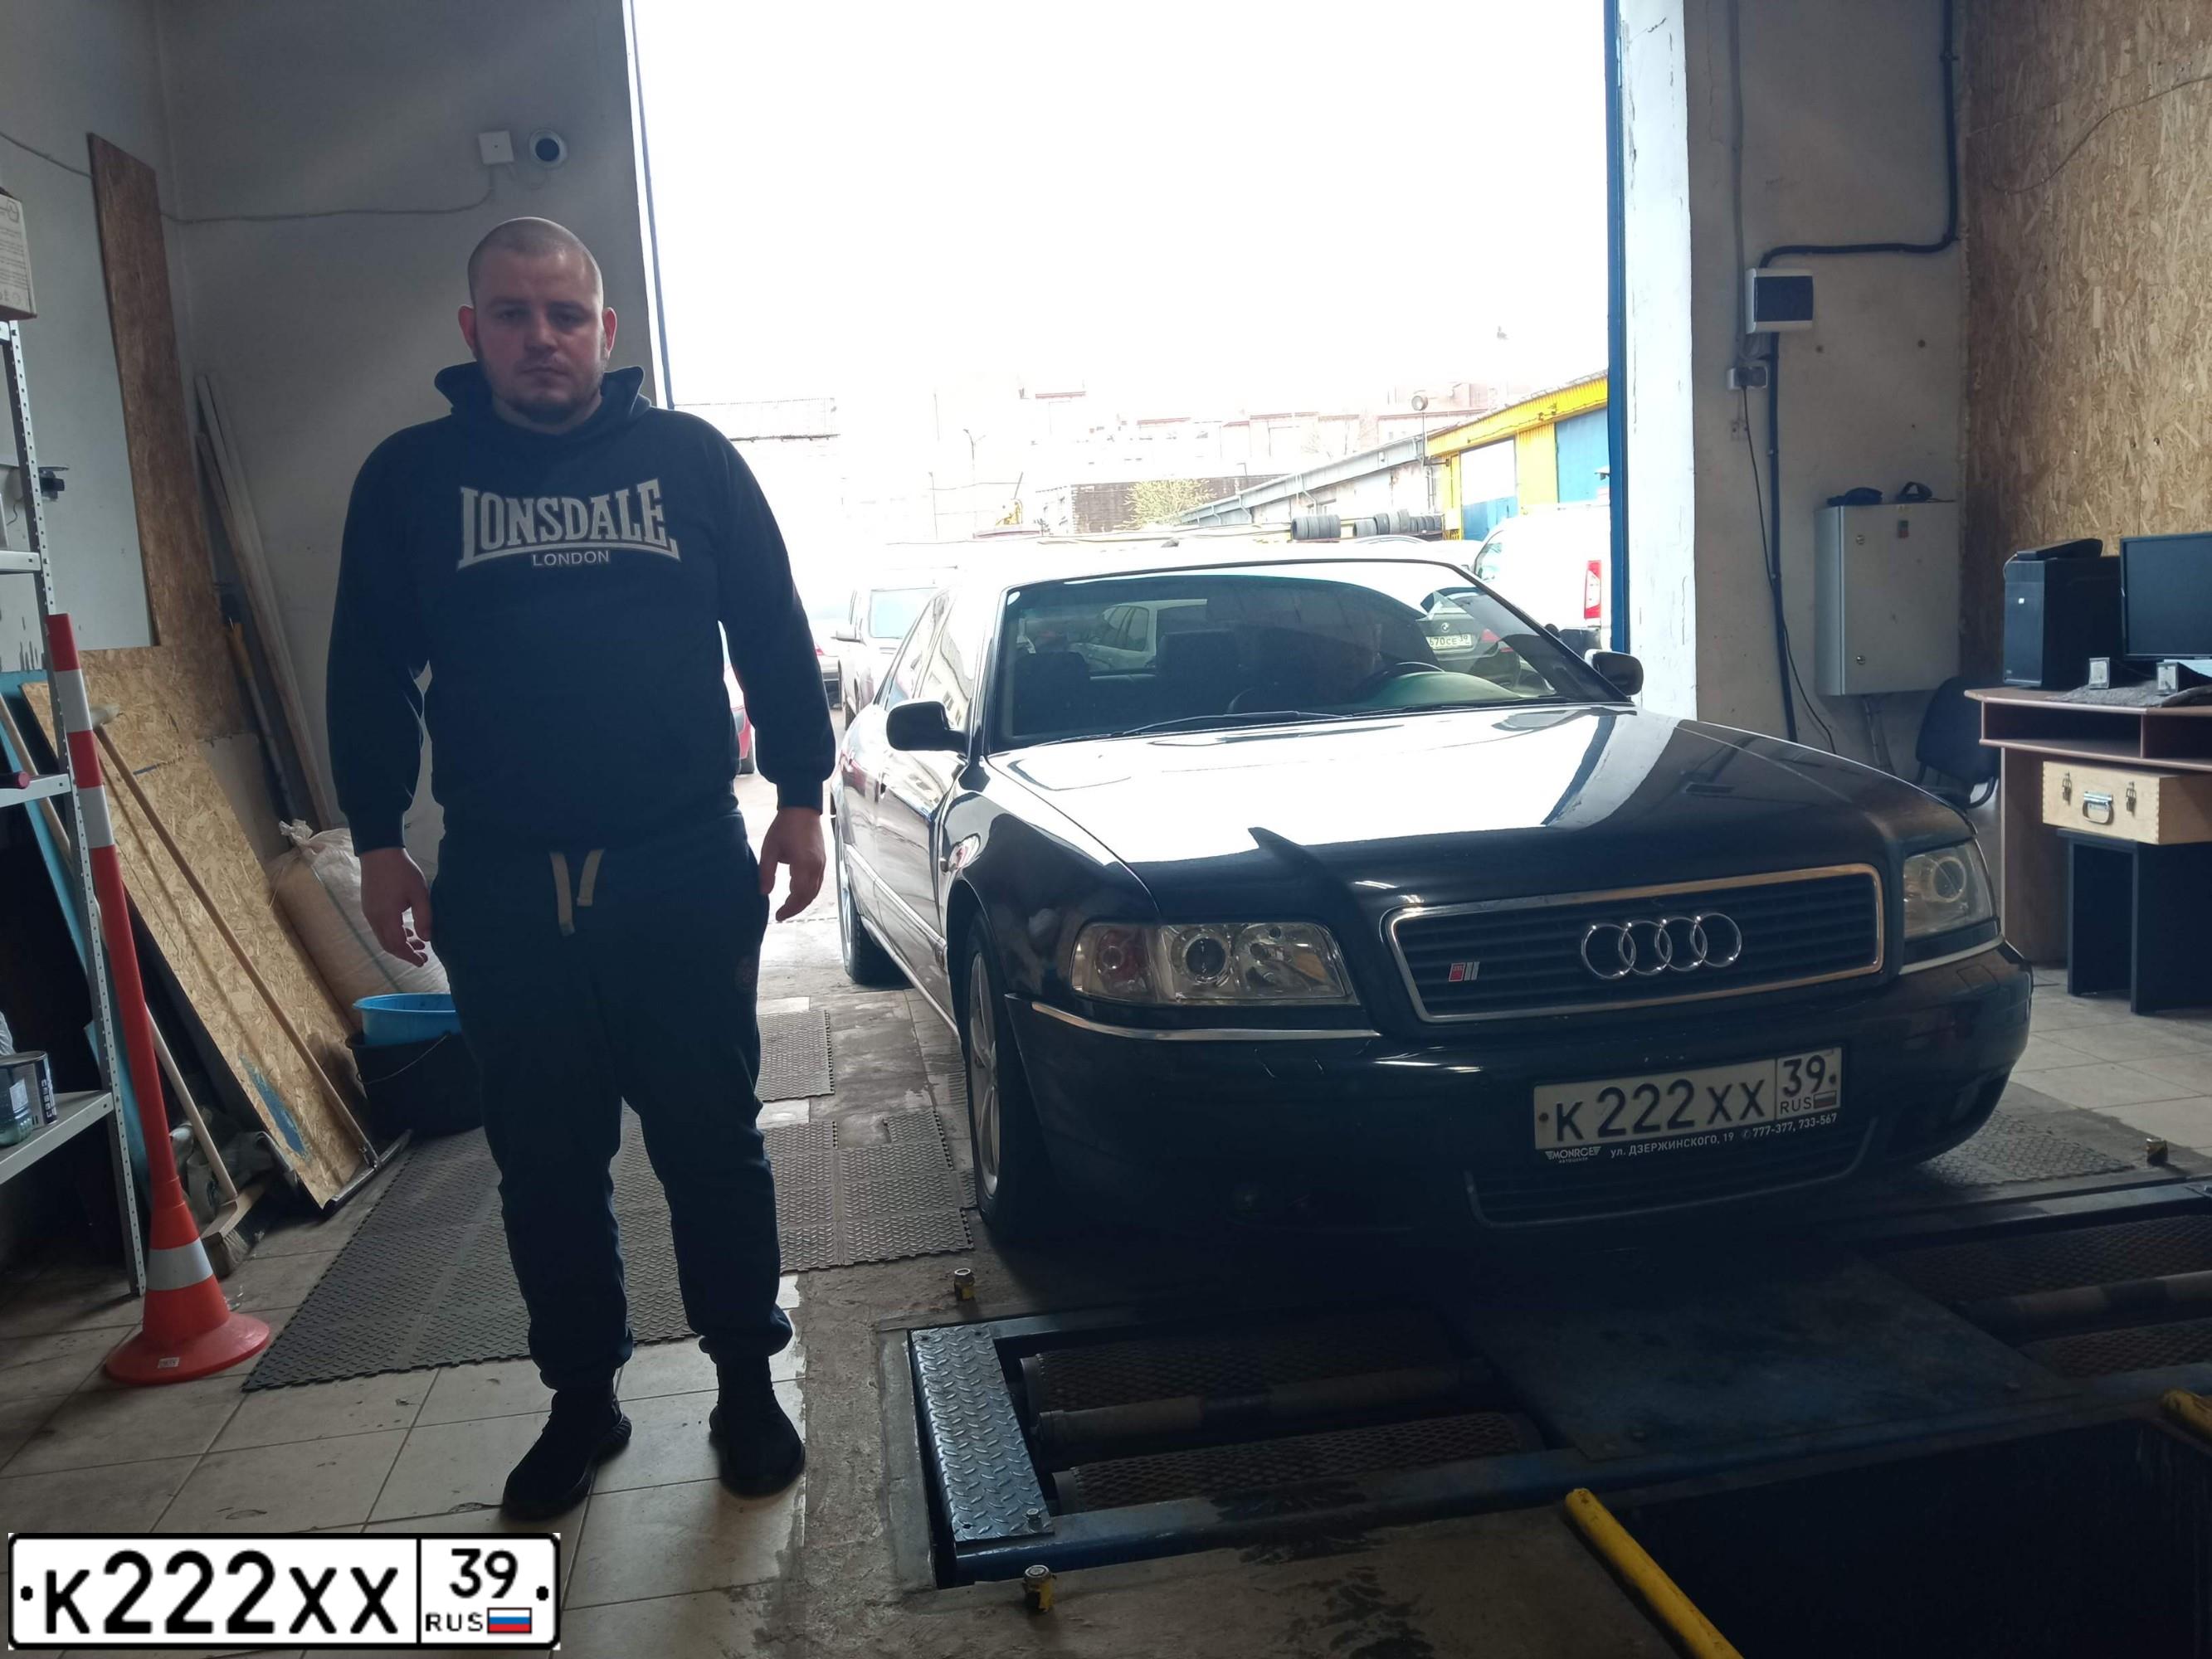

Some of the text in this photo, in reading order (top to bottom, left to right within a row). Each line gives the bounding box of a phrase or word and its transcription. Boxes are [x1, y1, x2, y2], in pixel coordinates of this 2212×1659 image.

[458, 478, 680, 569] LONSDALE
[532, 550, 610, 567] LONDON
[1781, 1054, 1826, 1097] 39
[1779, 1096, 1813, 1116] RUS
[1610, 1112, 1838, 1159] ул. ДЗЕРЖИНСКОГО, 19 777-377, 733-567
